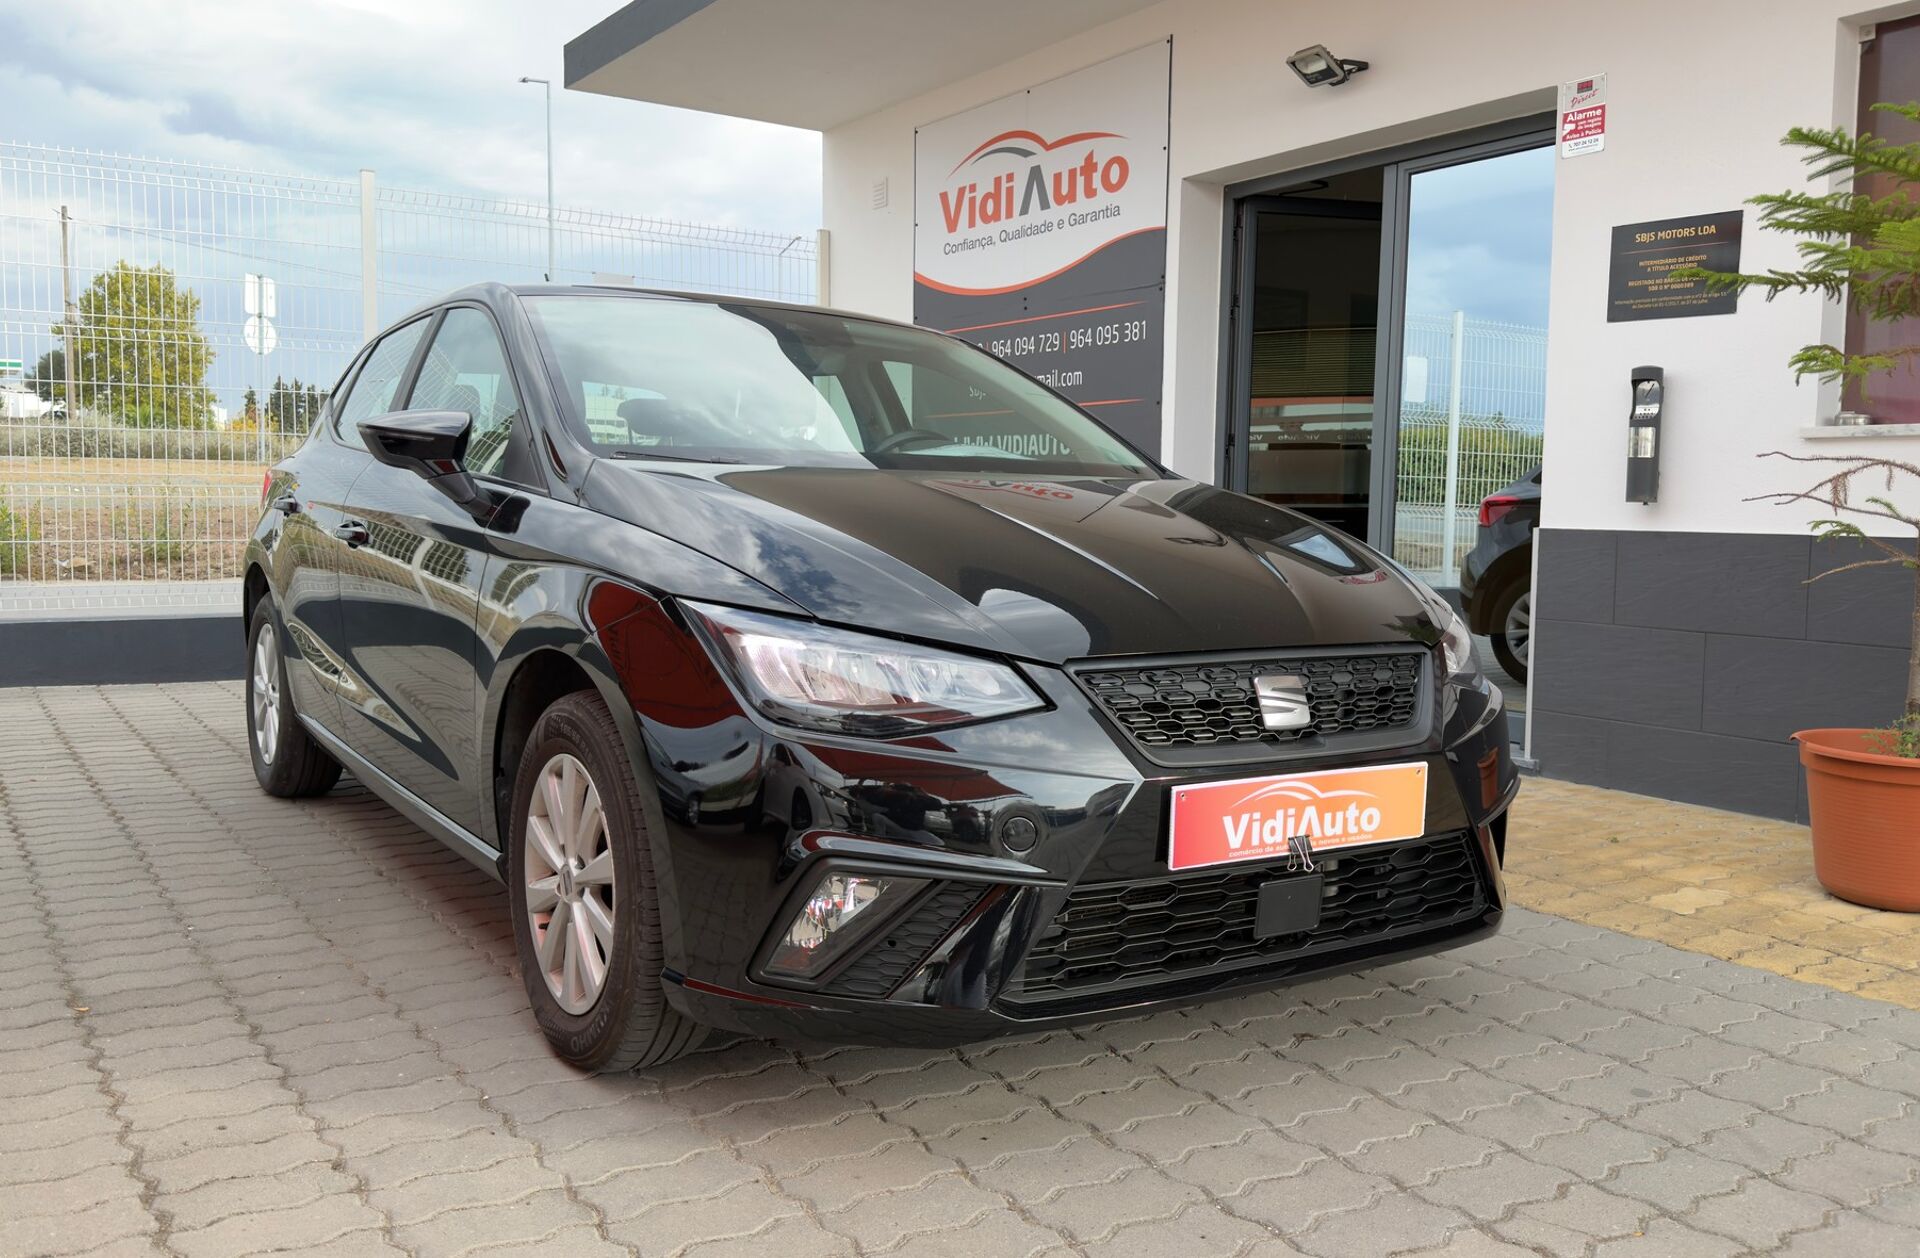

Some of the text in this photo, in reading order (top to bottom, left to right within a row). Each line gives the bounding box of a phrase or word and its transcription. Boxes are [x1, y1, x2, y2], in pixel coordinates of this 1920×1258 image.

[1566, 109, 1602, 122] Alarme
[939, 149, 1130, 234] VidiAuto
[943, 203, 1121, 256] Confiança, Qualidade e Garantia
[1635, 224, 1717, 243] SBJS MOTORS LDA
[992, 320, 1147, 358] 964 094 729 964 095 381
[1035, 369, 1083, 388] mail.com
[1222, 801, 1382, 850] VidiAuto
